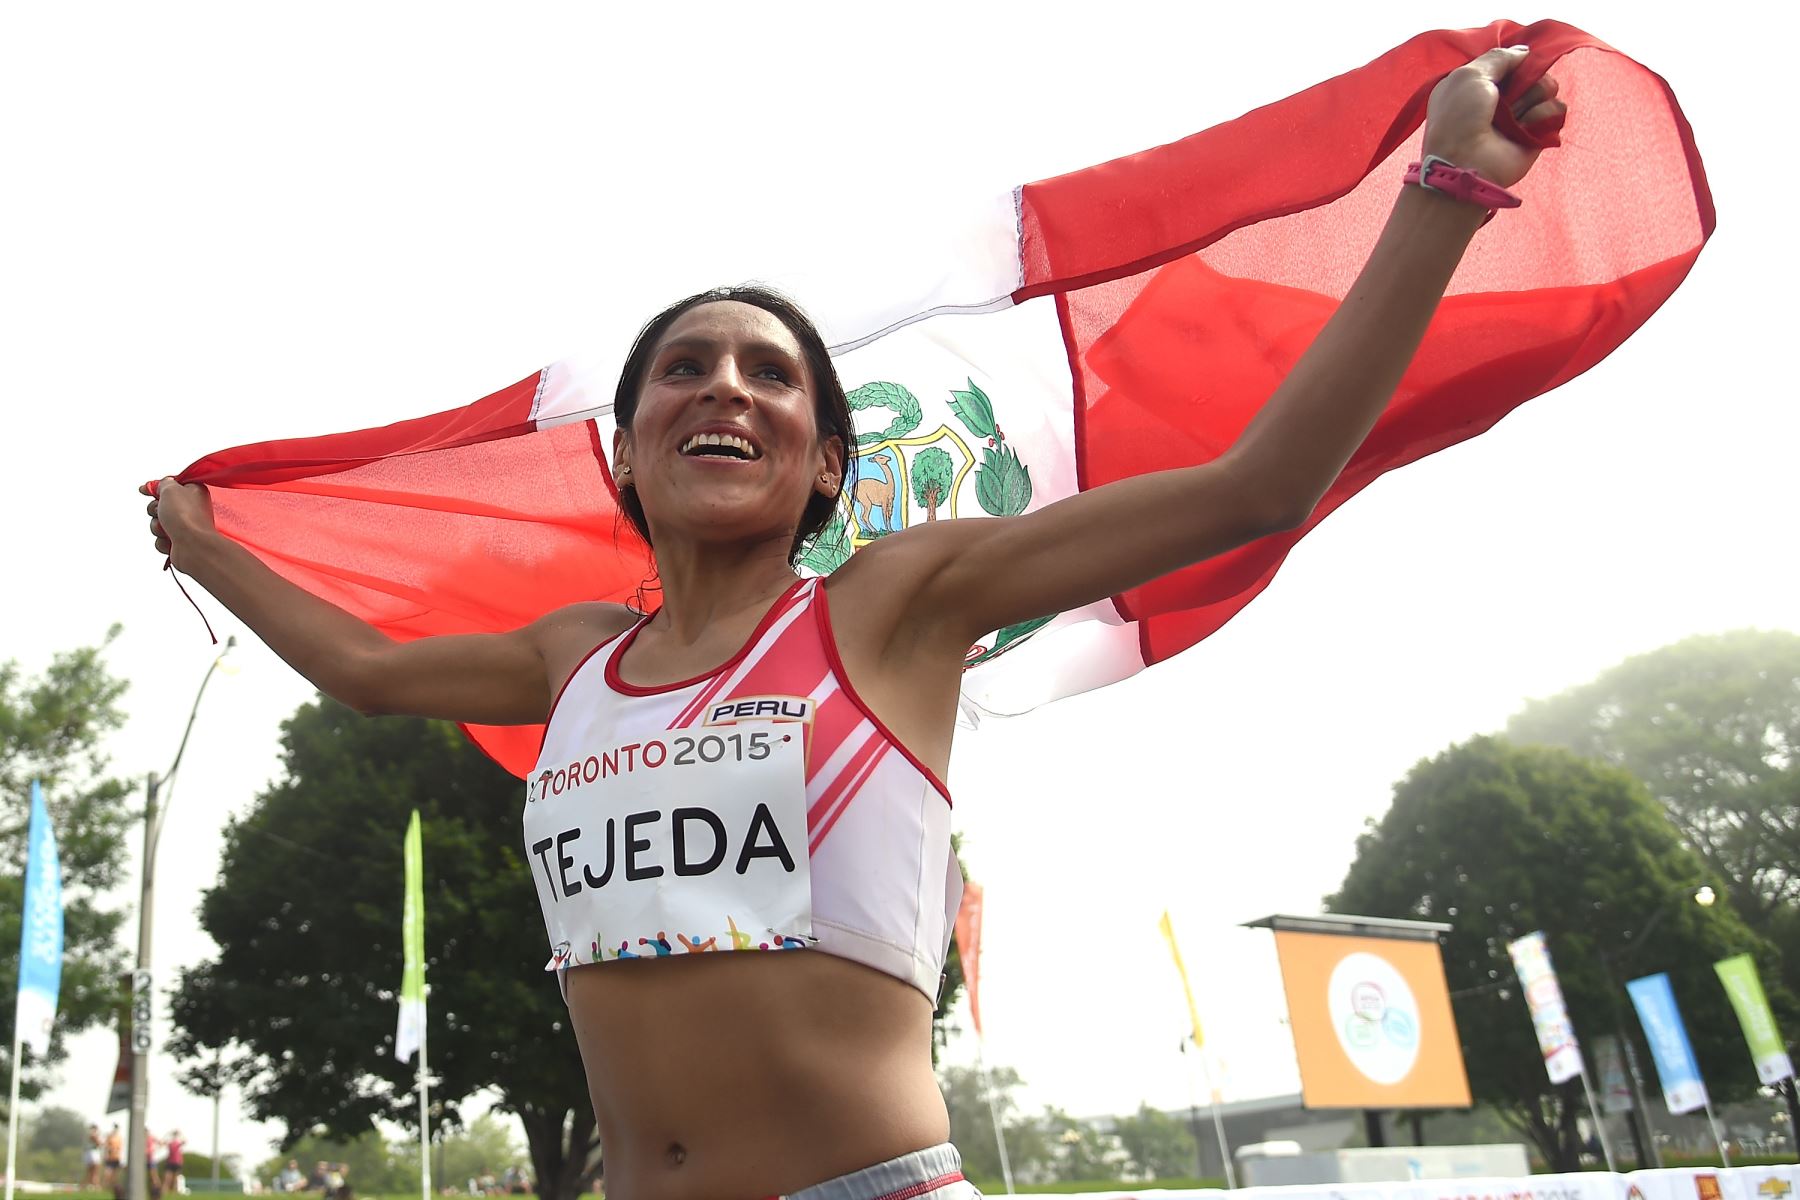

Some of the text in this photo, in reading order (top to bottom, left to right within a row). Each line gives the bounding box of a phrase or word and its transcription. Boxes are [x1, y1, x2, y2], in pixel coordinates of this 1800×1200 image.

[712, 700, 806, 721] PERU
[540, 732, 771, 800] TORONTO 2015
[532, 802, 796, 903] TEJEDA
